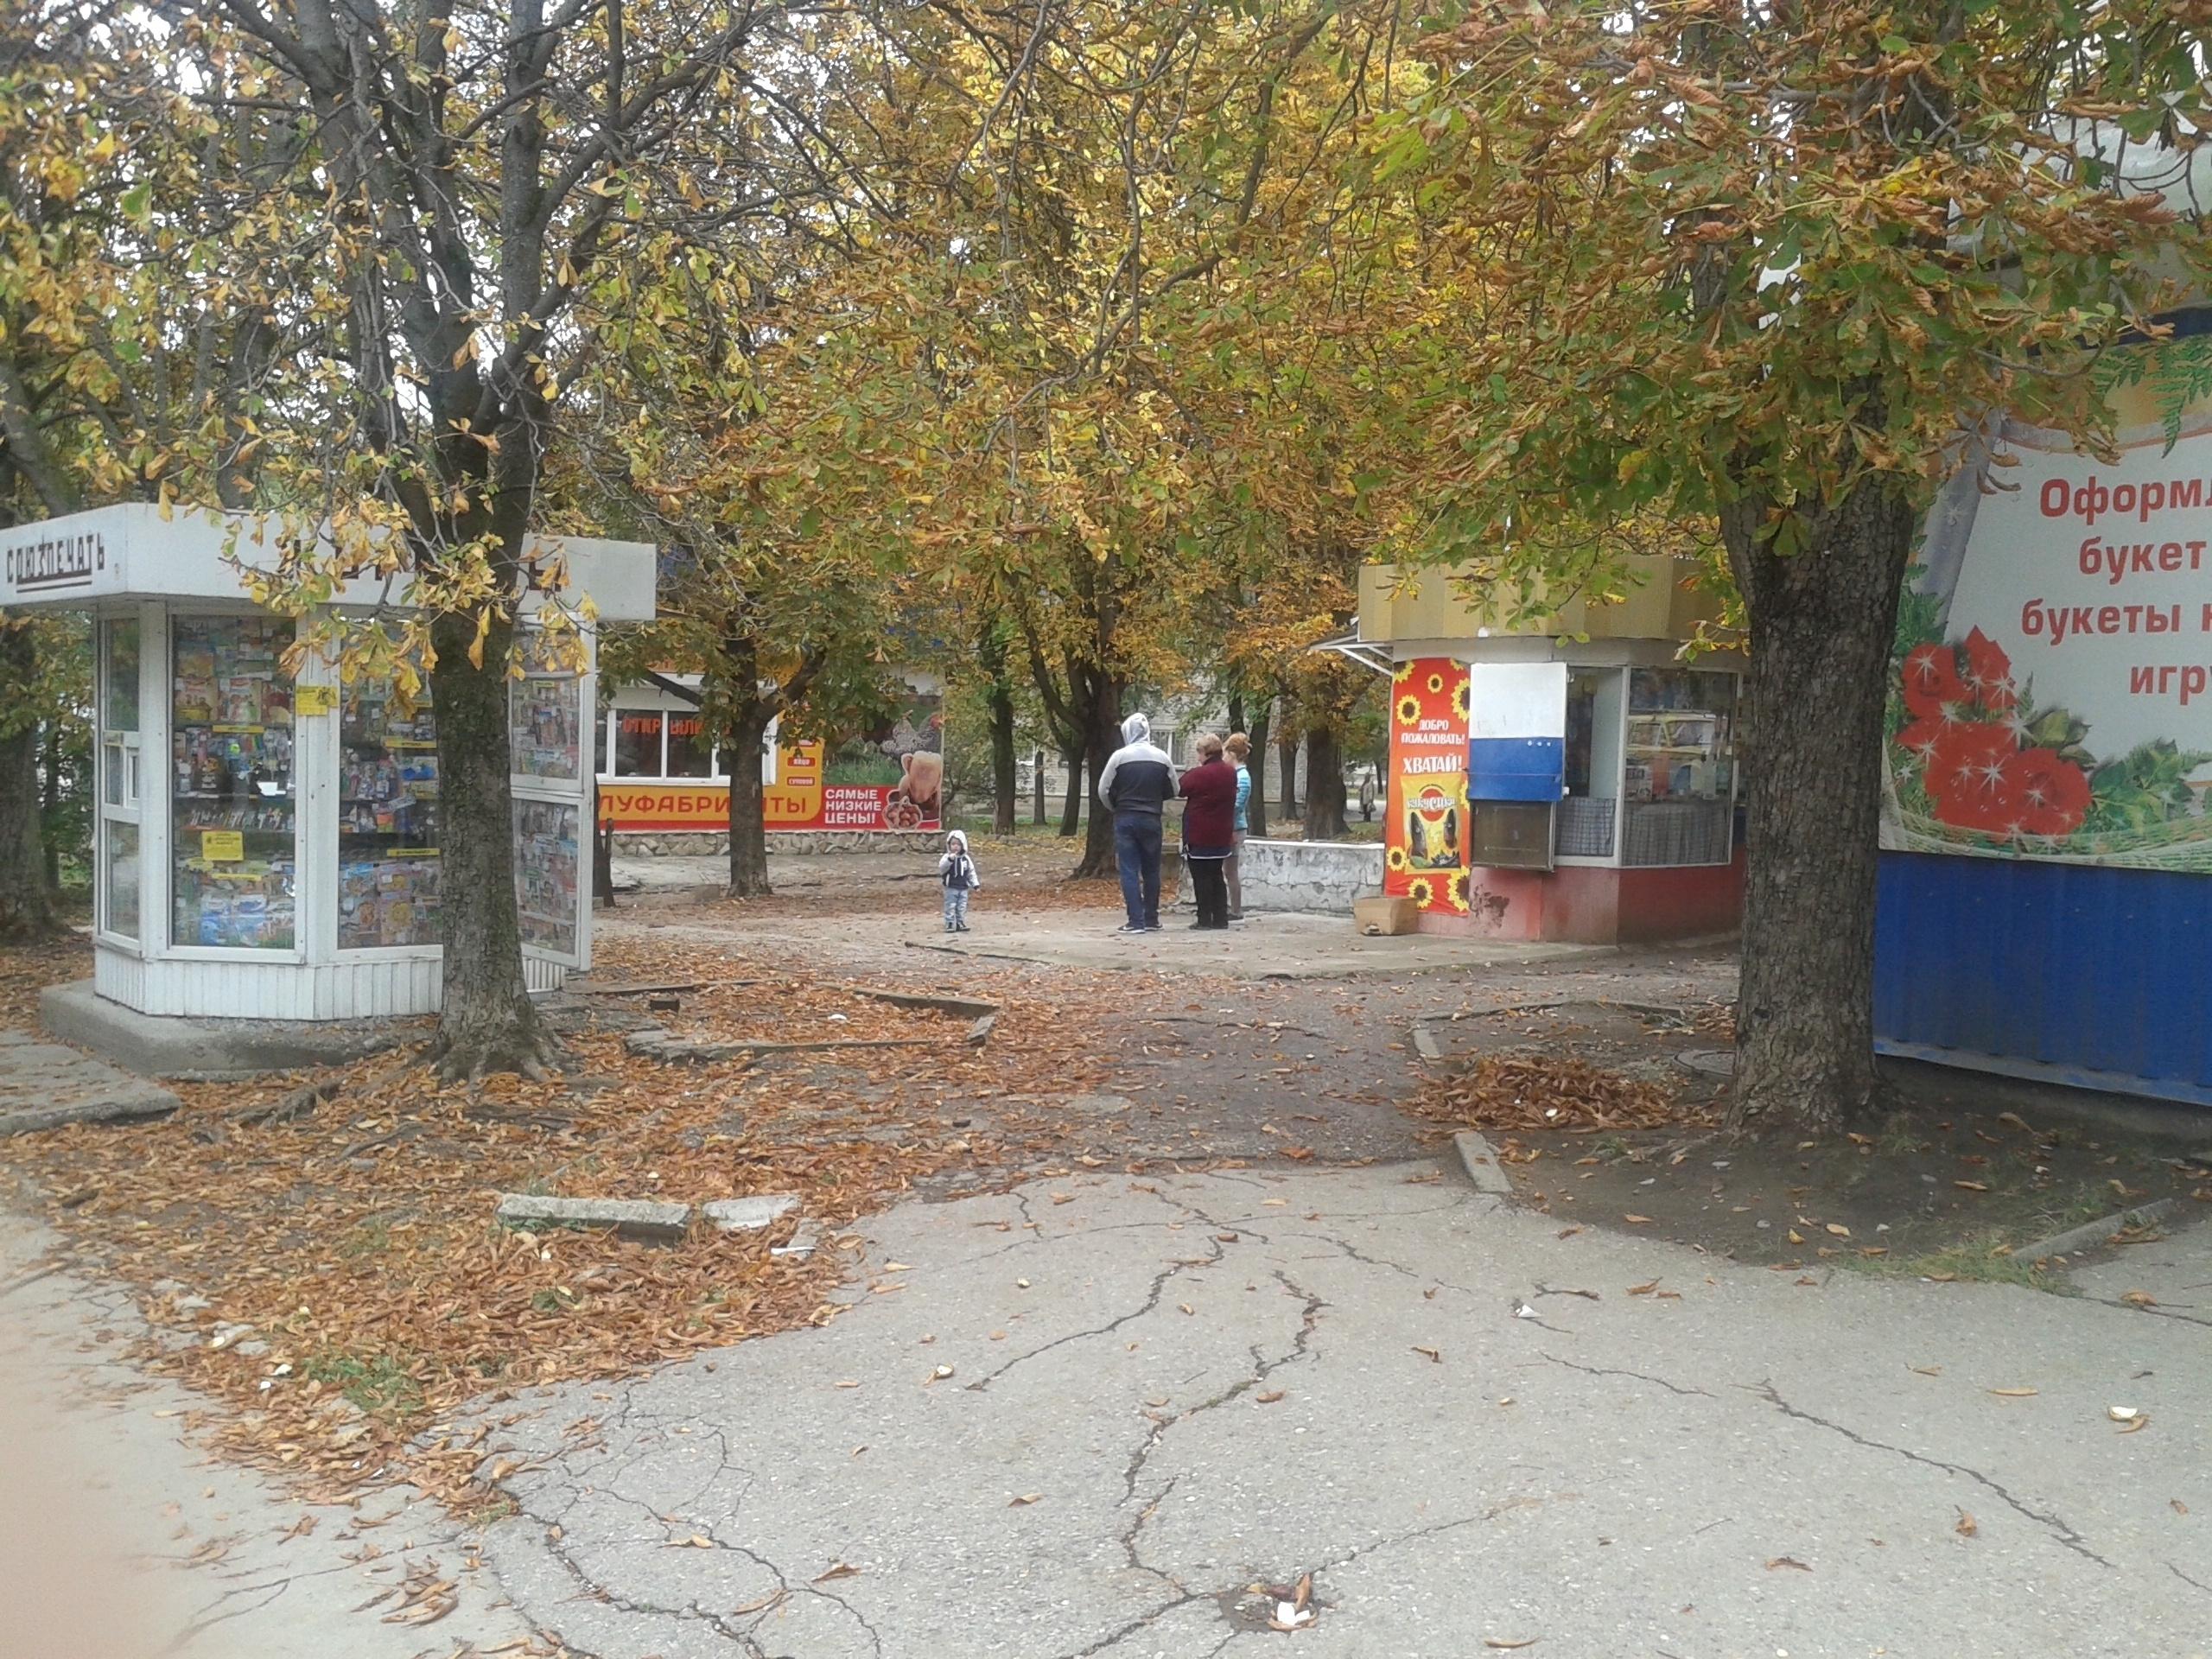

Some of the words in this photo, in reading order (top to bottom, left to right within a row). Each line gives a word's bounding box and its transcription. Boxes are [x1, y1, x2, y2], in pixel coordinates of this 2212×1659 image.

[2040, 476, 2212, 525] Оформ
[7, 532, 105, 584] СОЮЗПЕЧАТЬ
[2022, 598, 2181, 646] букеты
[2130, 665, 2212, 705] игр
[1418, 720, 1449, 731] ДОБРО
[1401, 733, 1465, 745] ПОЖАЛОВАТЬ!
[1403, 753, 1463, 773] ХВАТАЙ!
[825, 789, 878, 799] САМЫЕ
[826, 801, 881, 811] НИЗКИЕ
[825, 812, 875, 823] ЦЕНЫ!
